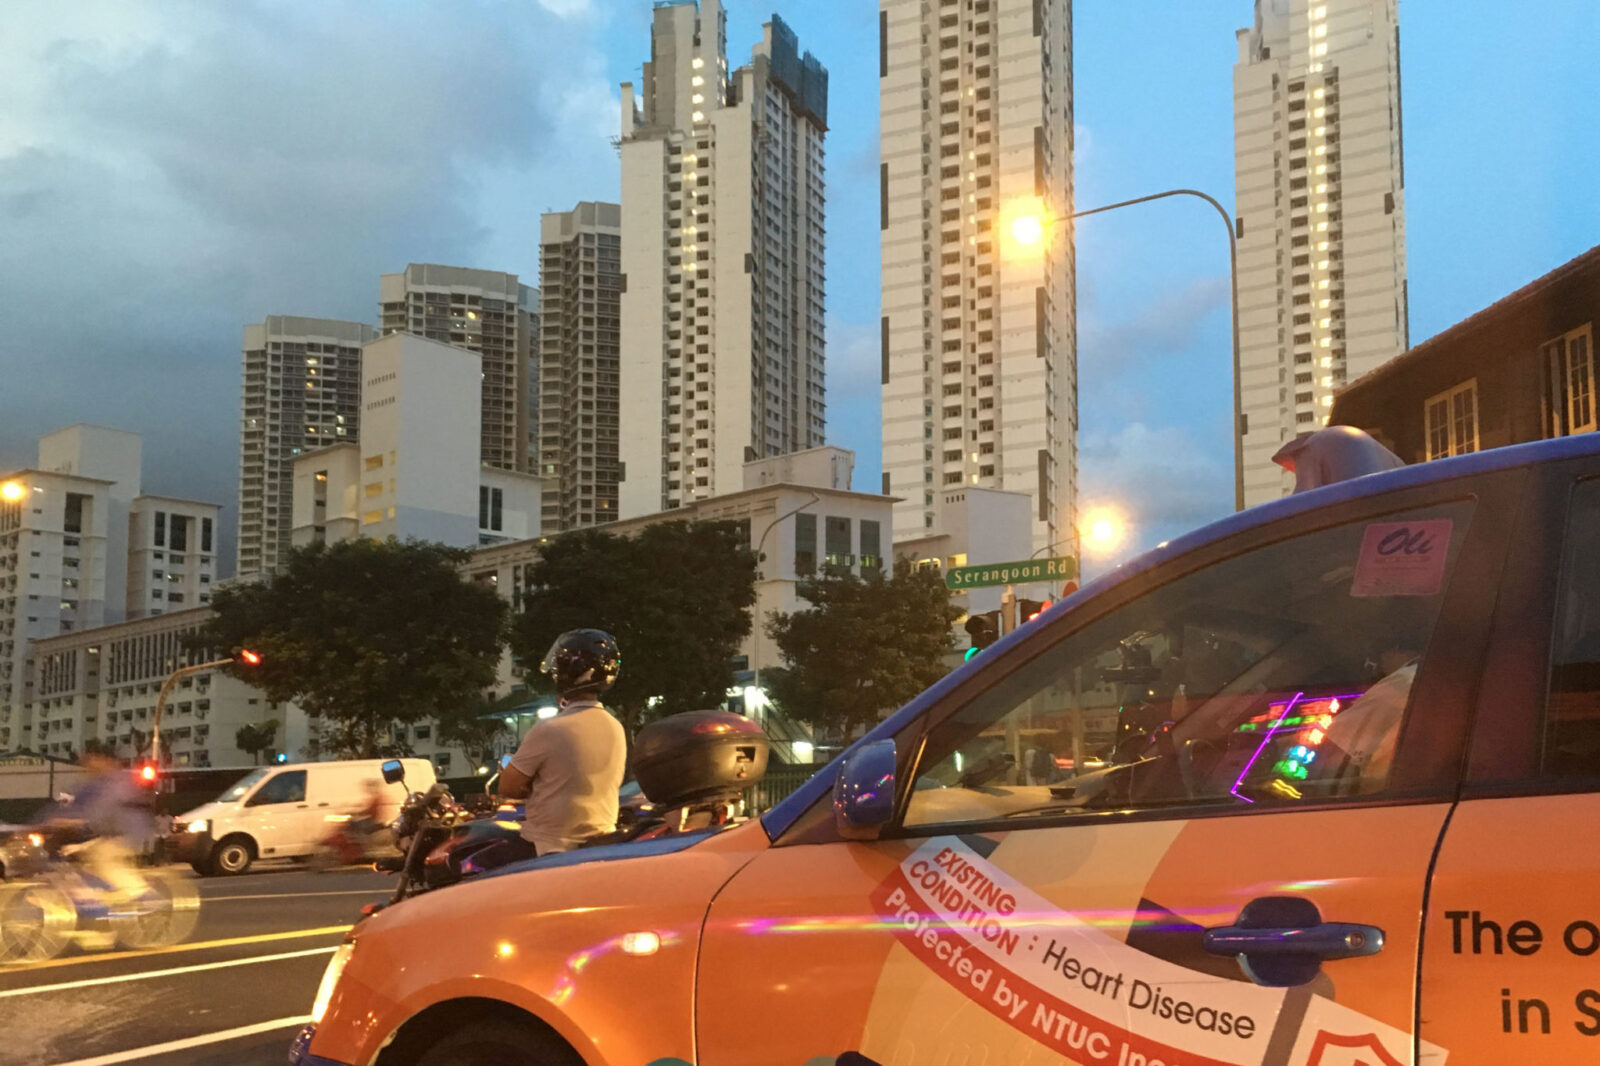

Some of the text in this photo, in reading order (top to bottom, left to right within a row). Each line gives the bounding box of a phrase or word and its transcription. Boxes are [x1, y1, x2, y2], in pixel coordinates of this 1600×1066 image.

[954, 559, 1067, 584] Serangoon Rd
[932, 847, 1017, 917] EXISTING
[909, 860, 1020, 956] CONDITION
[1042, 939, 1124, 1000] Heart
[1128, 979, 1256, 1039] Disease
[1444, 910, 1544, 956] The
[885, 887, 993, 992] Protected
[992, 978, 1029, 1020] by
[1031, 1003, 1111, 1059] NTUC
[1501, 988, 1552, 1034] in
